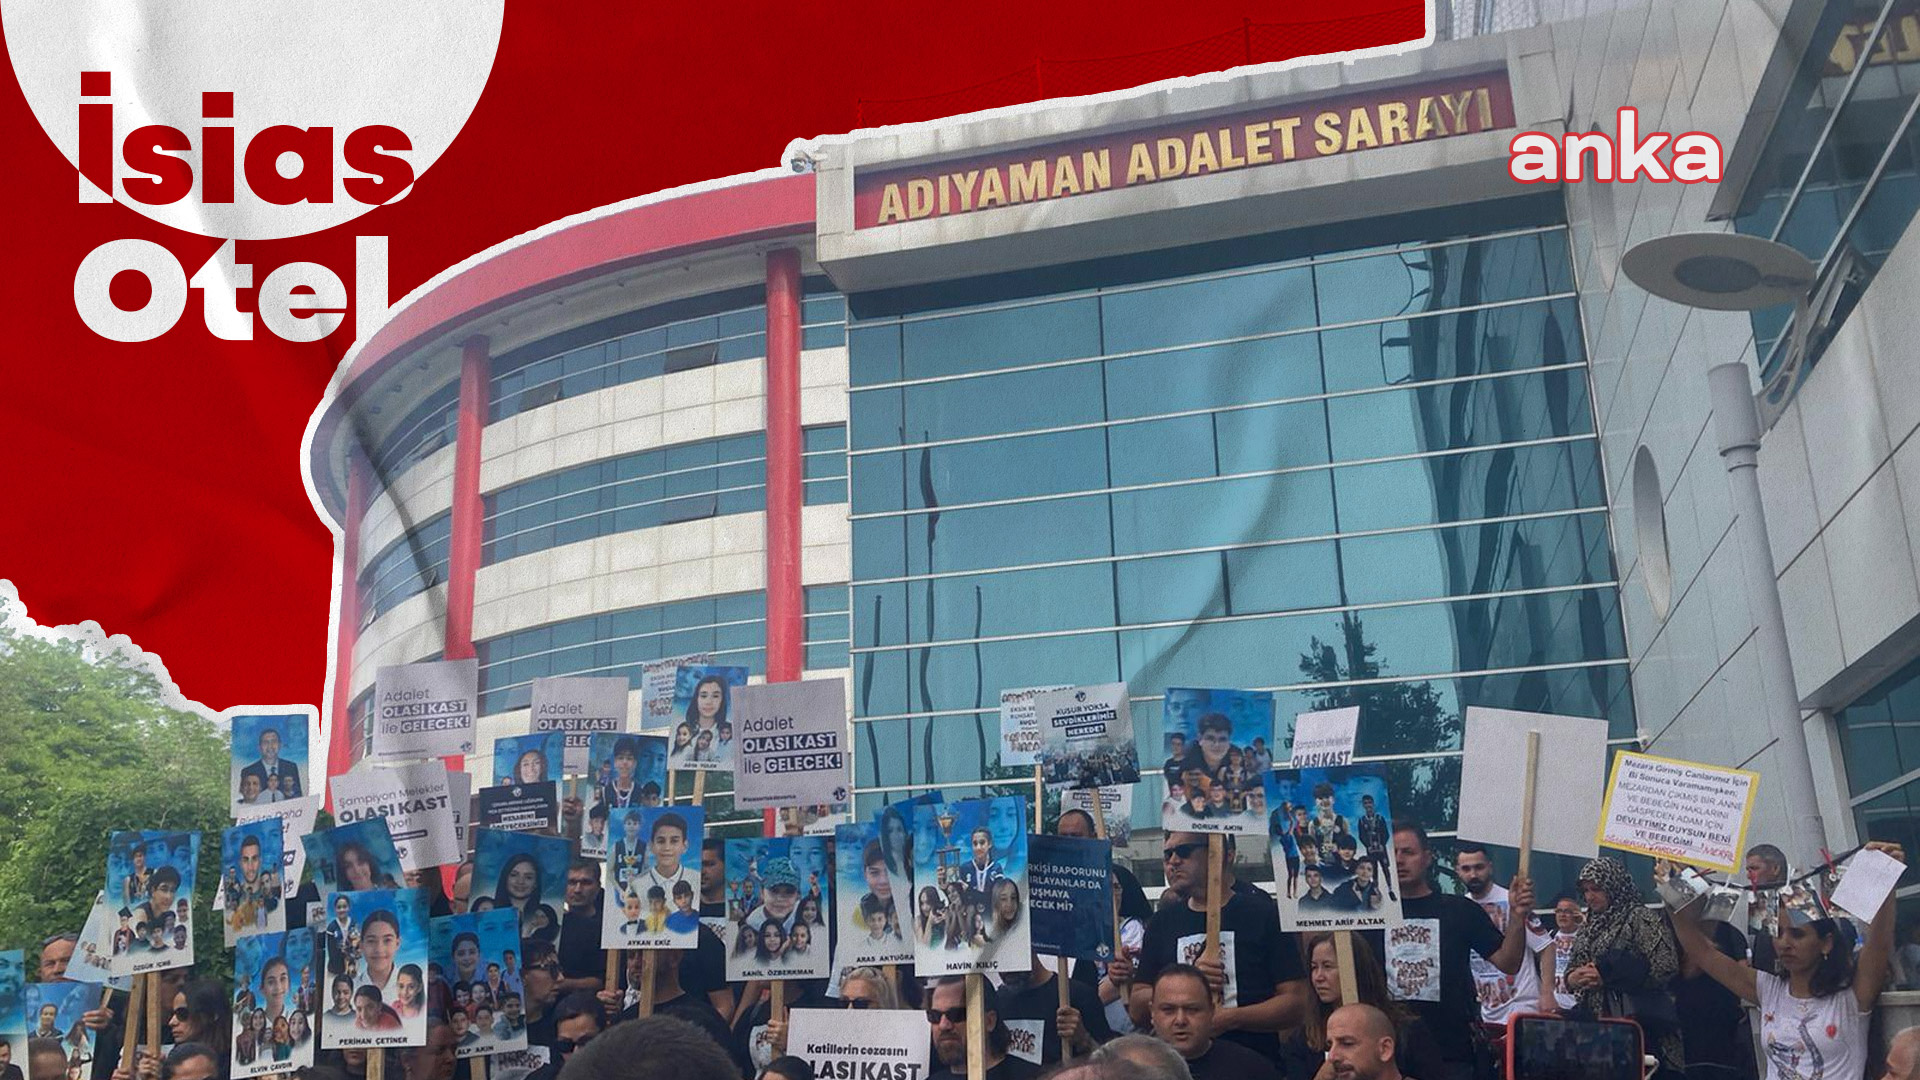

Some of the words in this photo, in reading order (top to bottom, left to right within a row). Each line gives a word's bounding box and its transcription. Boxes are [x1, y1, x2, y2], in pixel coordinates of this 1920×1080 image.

[877, 149, 1112, 226] ADIYAMAN
[1126, 117, 1301, 185] ADALET
[1314, 87, 1494, 156] SARAYI
[384, 688, 430, 701] Adalet
[383, 704, 425, 718] OLASI
[428, 701, 466, 714] KAST
[539, 702, 583, 714] Adalet
[1056, 706, 1083, 715] KUSUR
[1083, 703, 1110, 712] YOKSA
[402, 716, 470, 732] GELECEK!
[538, 719, 577, 730] OLASI
[580, 719, 617, 730] KAST
[743, 716, 794, 732] Adalet
[1053, 711, 1116, 727] SEVDİKLERİMİZ
[1066, 725, 1105, 736] NEREDE?
[743, 737, 790, 753] OLASI
[793, 733, 836, 749] KAST
[766, 754, 842, 772] GELECEK!
[1321, 750, 1351, 766] KAST
[340, 803, 396, 822] OLASI
[398, 795, 448, 816] KAST
[1191, 822, 1219, 830] DORUK
[1028, 863, 1051, 875] RKİŞİ
[1052, 865, 1106, 878] RAPORUNU
[1029, 875, 1086, 888] IRLAYANLAR
[1088, 880, 1102, 890] DA
[1031, 887, 1070, 899] UŞMAYA
[1030, 899, 1055, 910] ECEK
[1056, 901, 1074, 911] Mİ?
[1296, 919, 1332, 927] MEHMET
[1335, 918, 1355, 926] ARİF
[1357, 917, 1386, 925] ALTAK
[879, 953, 915, 962] AKTUĞRA
[946, 961, 972, 970] HAVİN
[976, 960, 999, 970] KILIÇ
[742, 969, 764, 977] SAHİL
[338, 1036, 372, 1046] PERİHAN
[375, 1036, 409, 1046] ÇETİNER
[807, 1043, 859, 1056] Katillerin
[860, 1046, 908, 1057] cezasını
[811, 1060, 857, 1080] LASI
[861, 1061, 922, 1080] KAST
